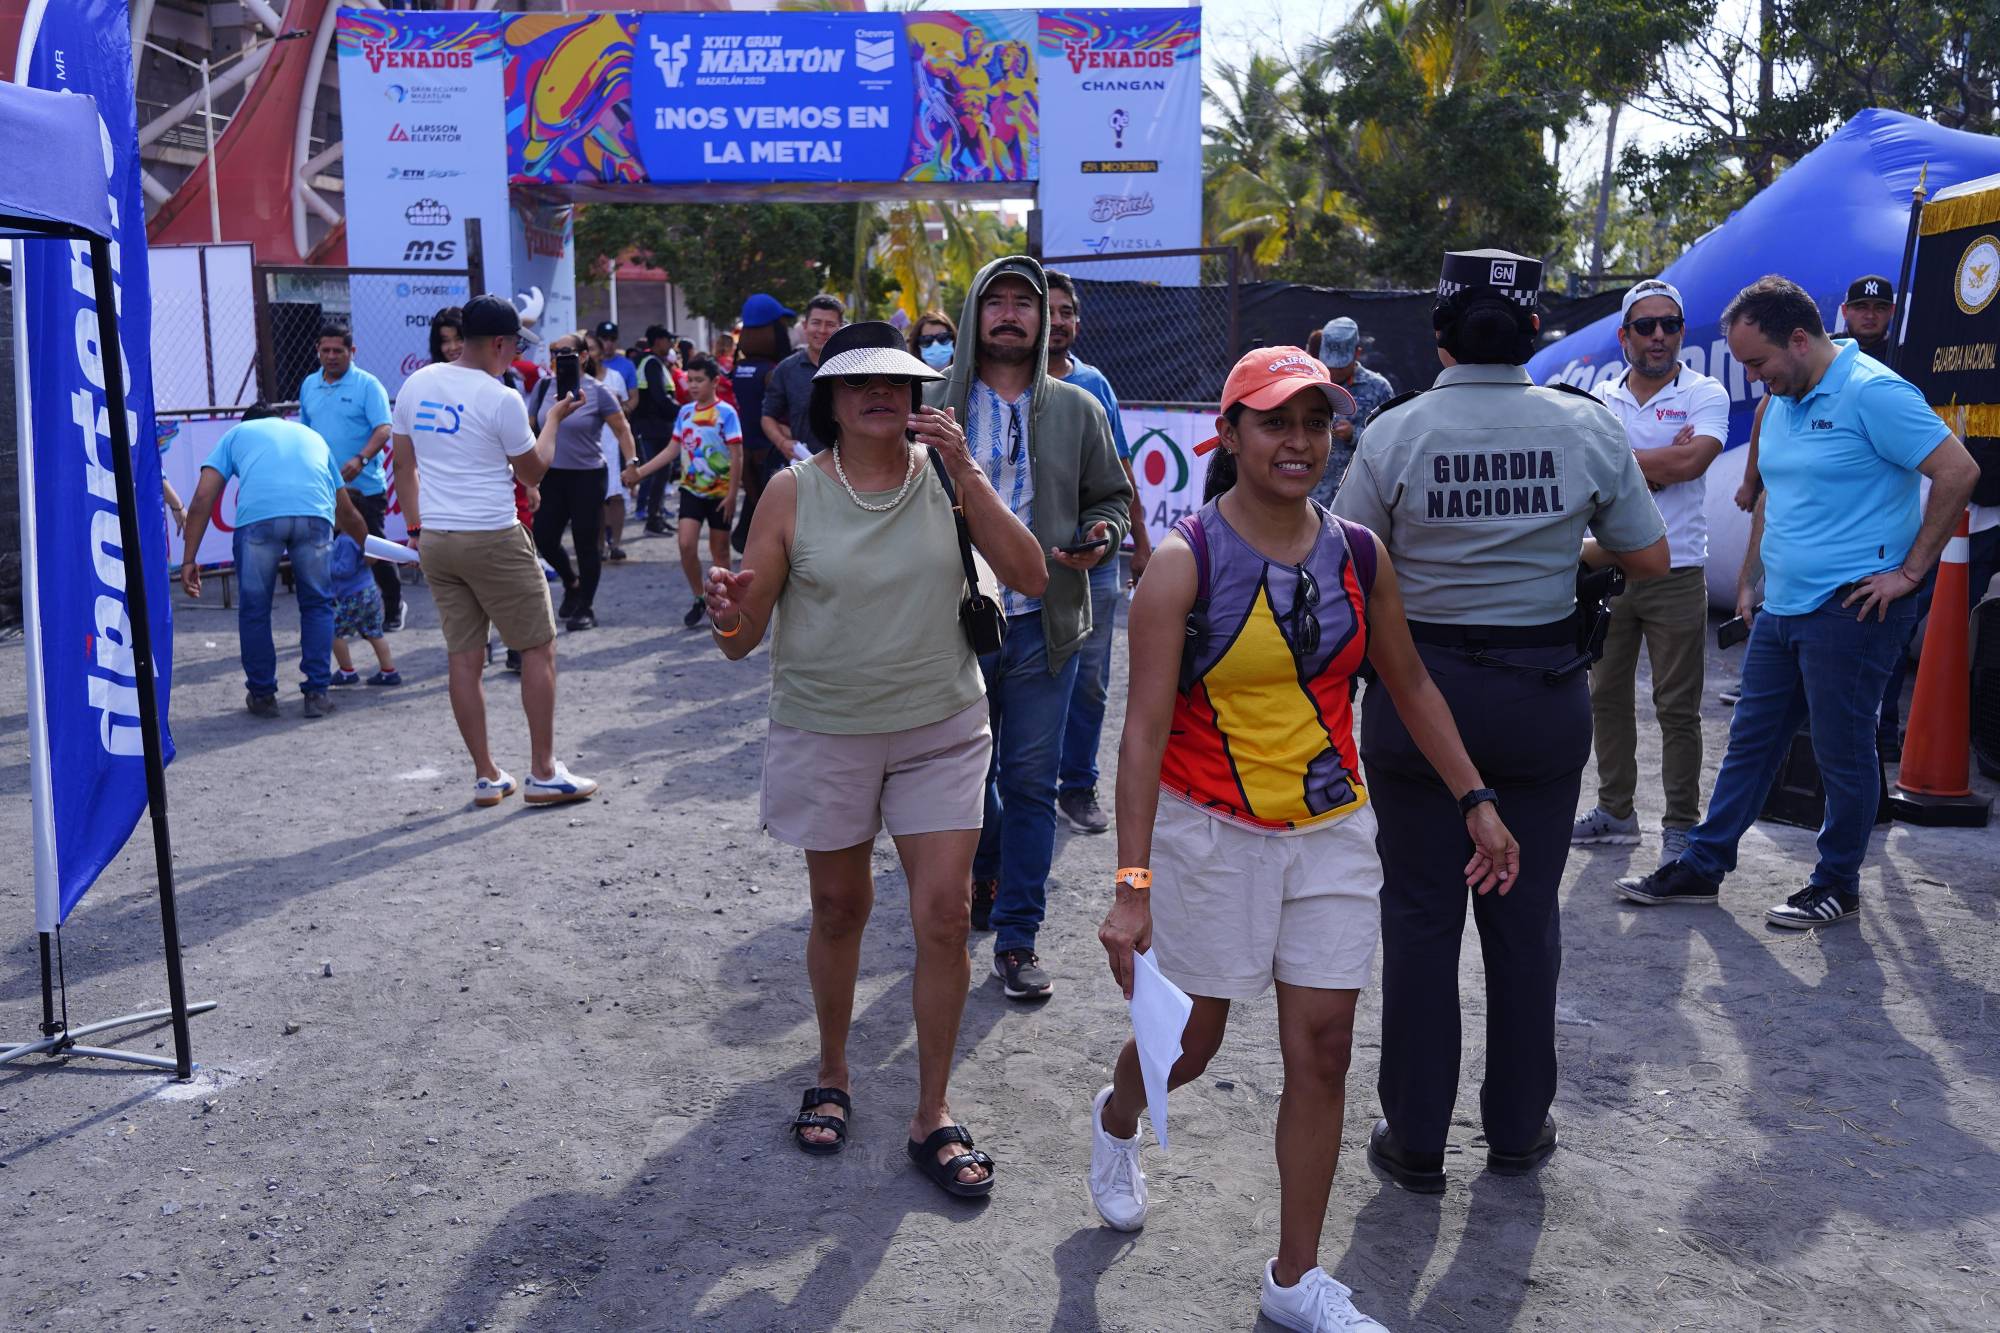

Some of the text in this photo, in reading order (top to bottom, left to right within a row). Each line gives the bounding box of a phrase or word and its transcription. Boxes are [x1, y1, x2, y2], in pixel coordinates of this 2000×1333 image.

[702, 35, 783, 49] XXIV GRAN
[56, 49, 65, 81] MR
[362, 39, 473, 73] VENADOS
[697, 46, 846, 74] MARATÓN
[1064, 39, 1175, 74] VENADOS
[744, 76, 767, 85] 2025
[1082, 80, 1165, 91] CHANGAN
[411, 124, 458, 133] LARSSON
[655, 106, 889, 130] ¡NOS VEMOS EN
[411, 134, 462, 142] ELEVATOR
[704, 141, 842, 164] LA META!
[1111, 239, 1162, 249] VIZSLA
[1493, 266, 1514, 281] GN
[1932, 342, 1998, 373] GUARDIA NACIONAL
[1433, 450, 1556, 484] GUARDIA
[1427, 485, 1564, 519] NACIONAL
